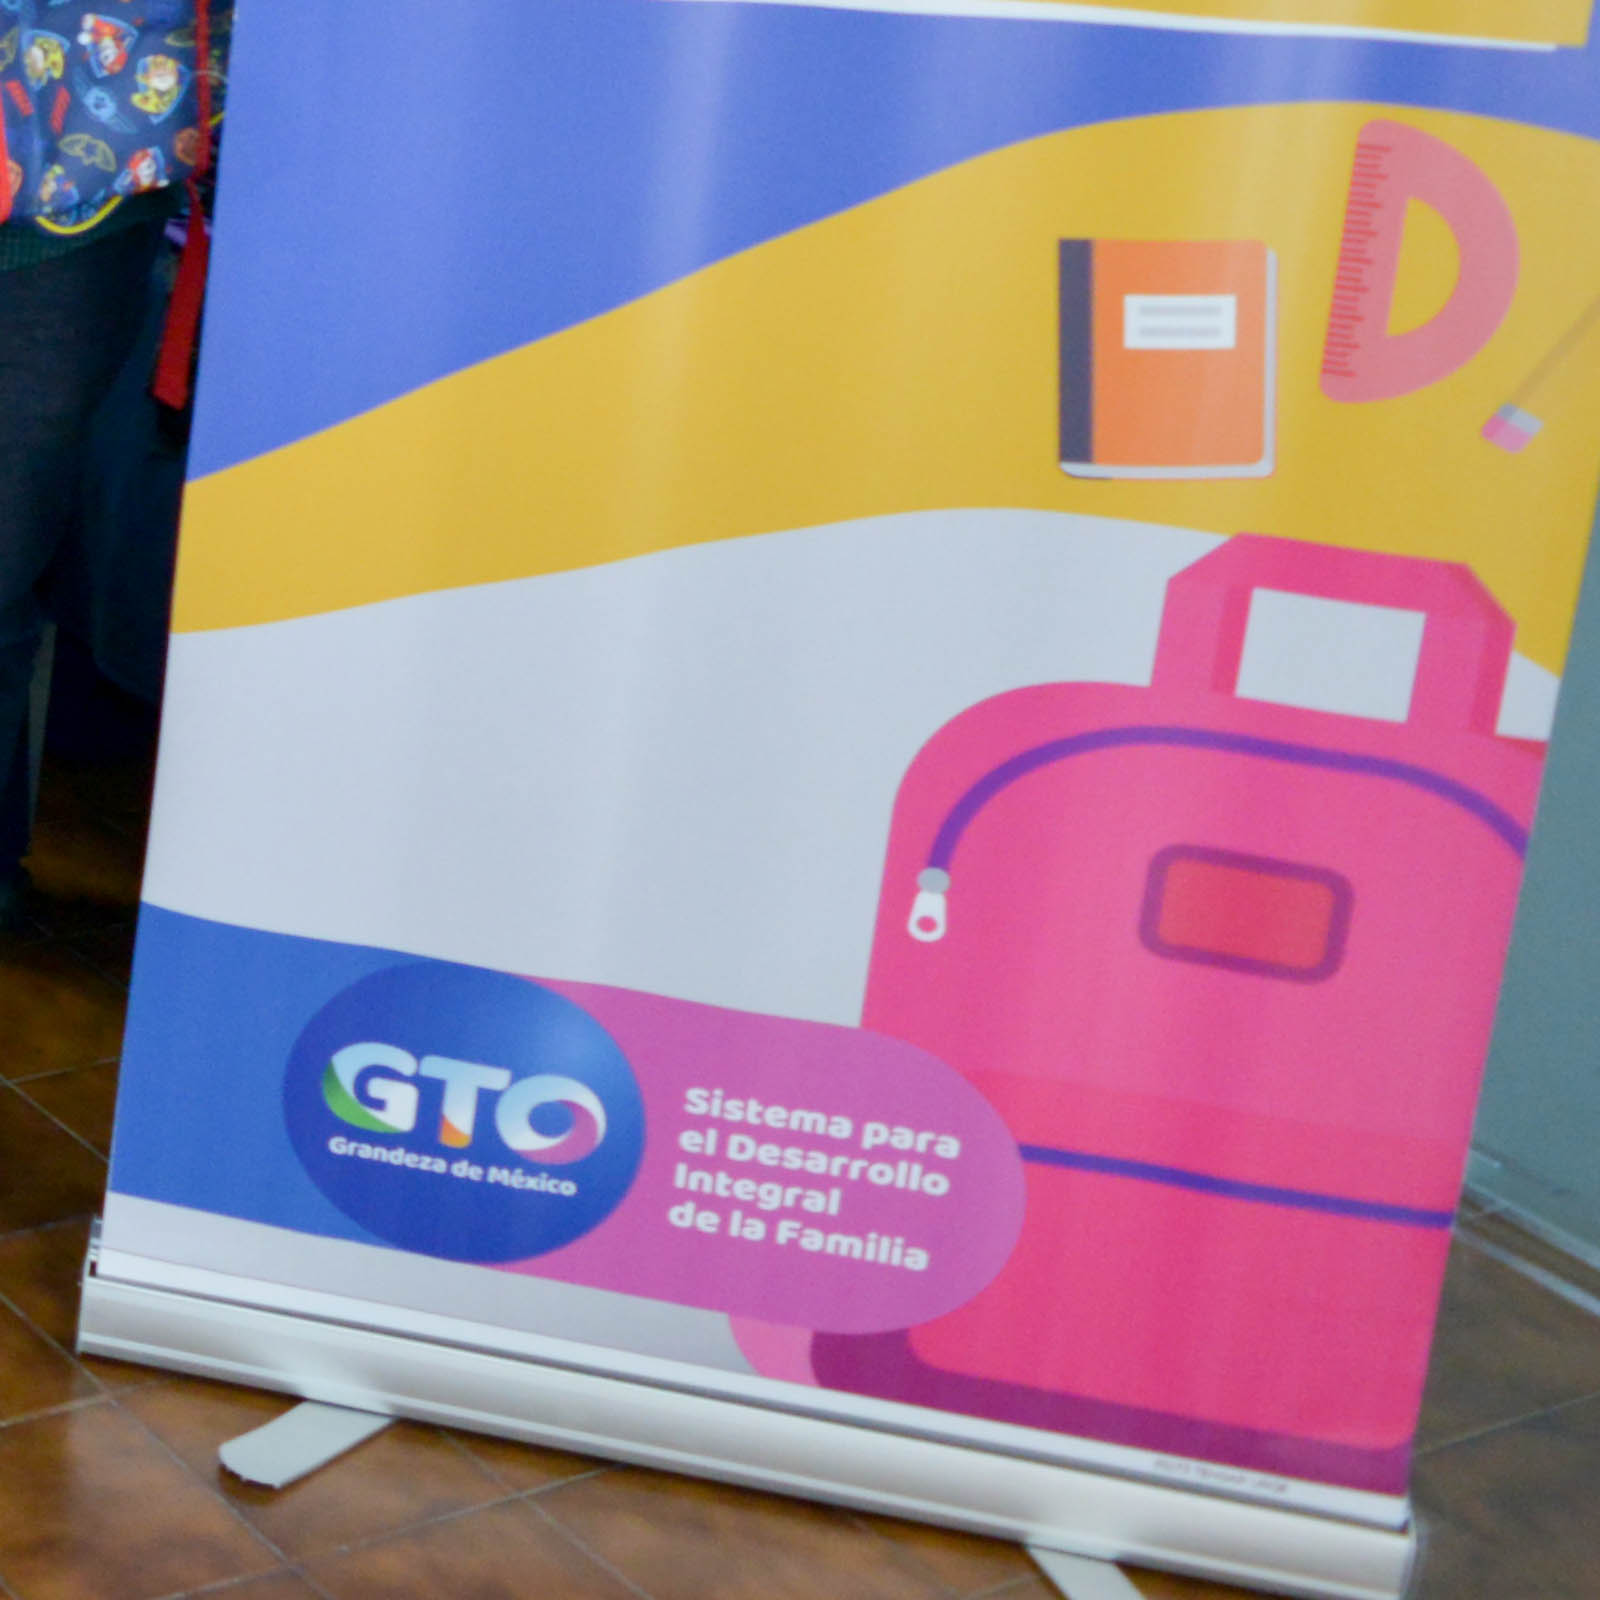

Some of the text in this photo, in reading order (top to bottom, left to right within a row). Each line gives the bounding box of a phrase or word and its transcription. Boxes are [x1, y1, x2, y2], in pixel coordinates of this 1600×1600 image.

[321, 1041, 608, 1166] GTO
[684, 1087, 961, 1159] Sistema para
[328, 1136, 577, 1197] Grandeza de México
[674, 1162, 842, 1216] Integral
[679, 1127, 950, 1196] el Desarrollo
[668, 1201, 929, 1271] de la Familia
